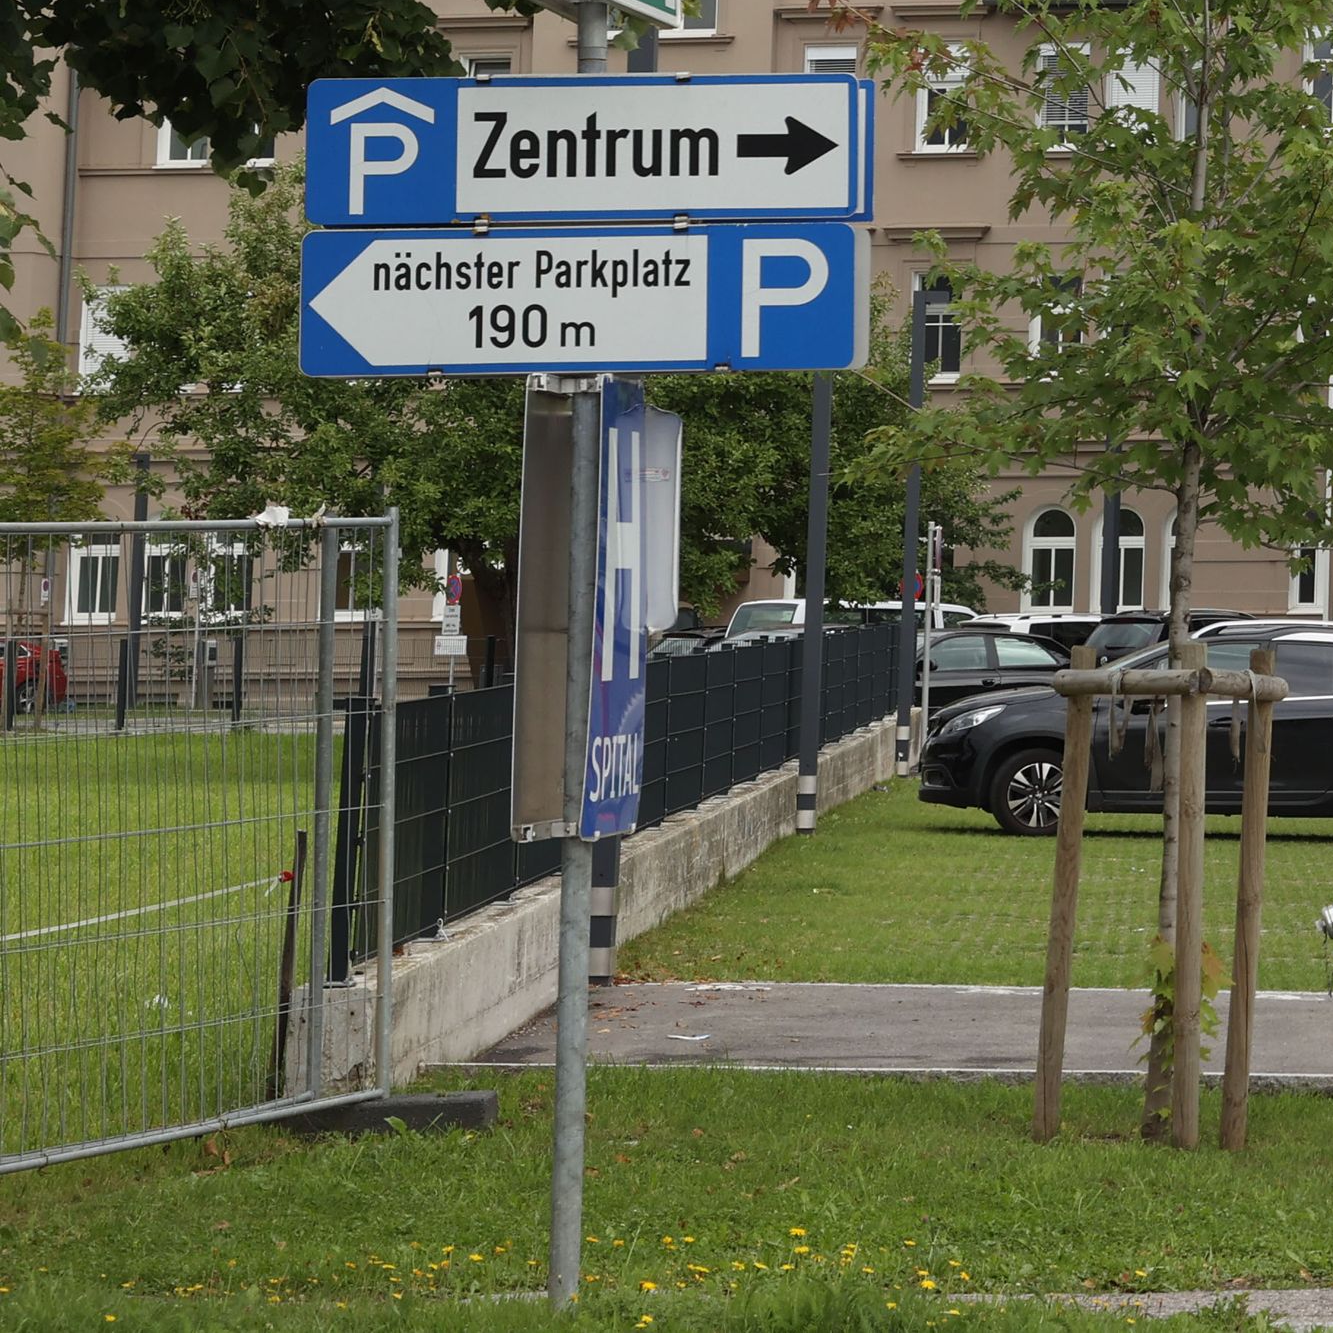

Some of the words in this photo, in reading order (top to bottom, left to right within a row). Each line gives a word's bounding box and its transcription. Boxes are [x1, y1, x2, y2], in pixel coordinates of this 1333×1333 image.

[348, 122, 419, 215] P
[472, 110, 720, 179] Zentrum
[372, 251, 521, 291] nächster
[534, 248, 691, 298] Parkplatz
[740, 238, 829, 358] P
[467, 303, 549, 349] 190
[560, 316, 596, 348] m
[601, 427, 640, 682] H
[588, 732, 640, 803] SPITAL
